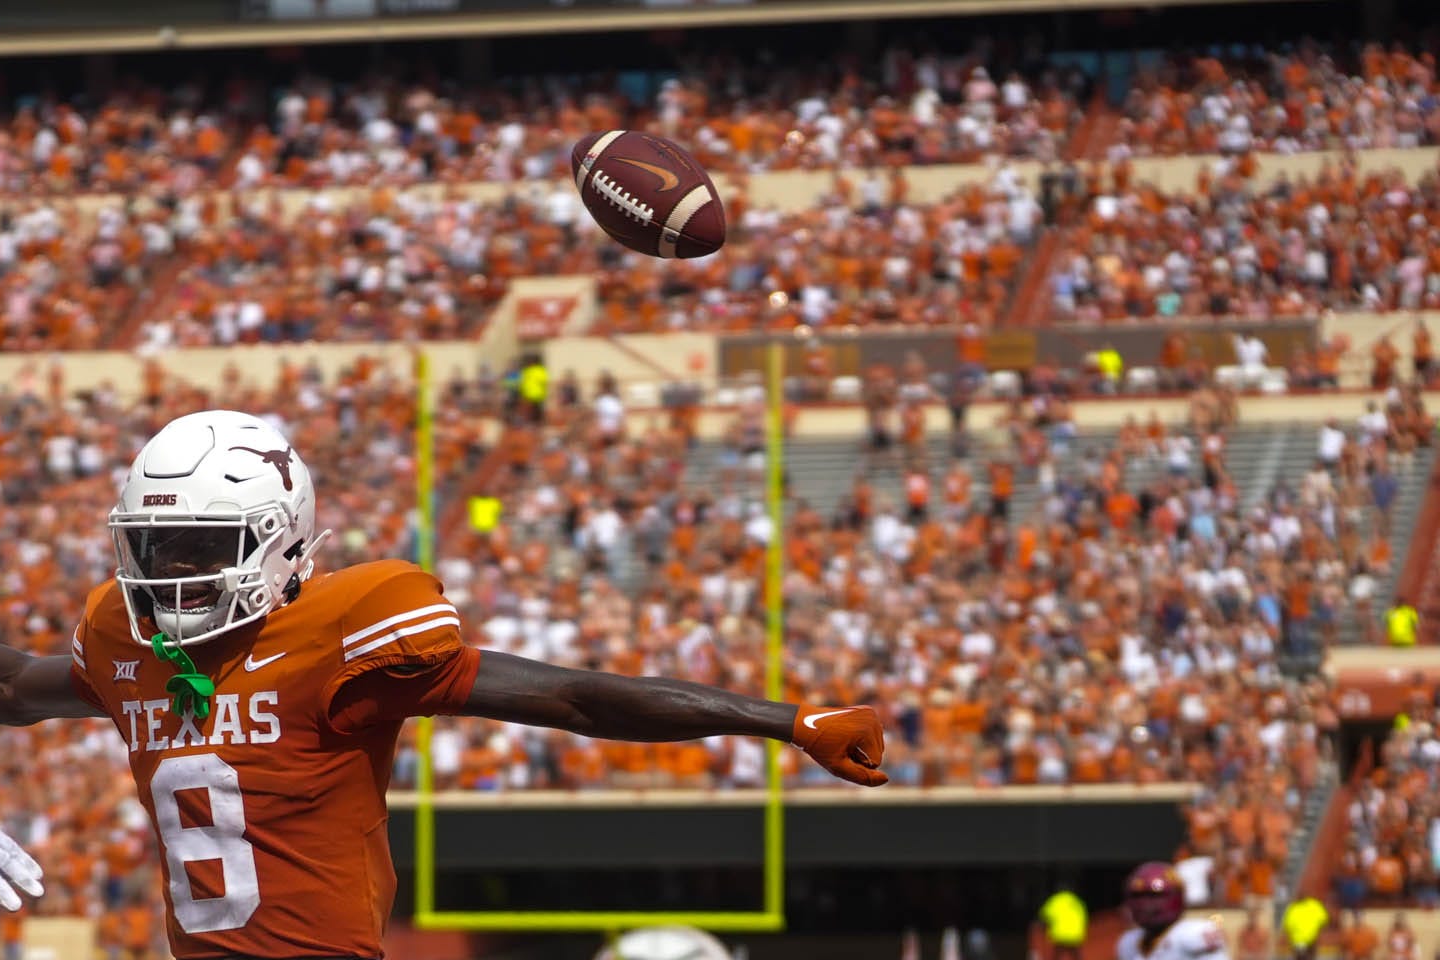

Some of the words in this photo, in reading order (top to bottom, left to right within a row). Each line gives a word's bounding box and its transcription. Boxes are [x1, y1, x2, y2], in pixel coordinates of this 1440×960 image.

[143, 494, 177, 507] HORNS
[122, 691, 281, 752] TEXAS
[150, 753, 261, 934] 8
